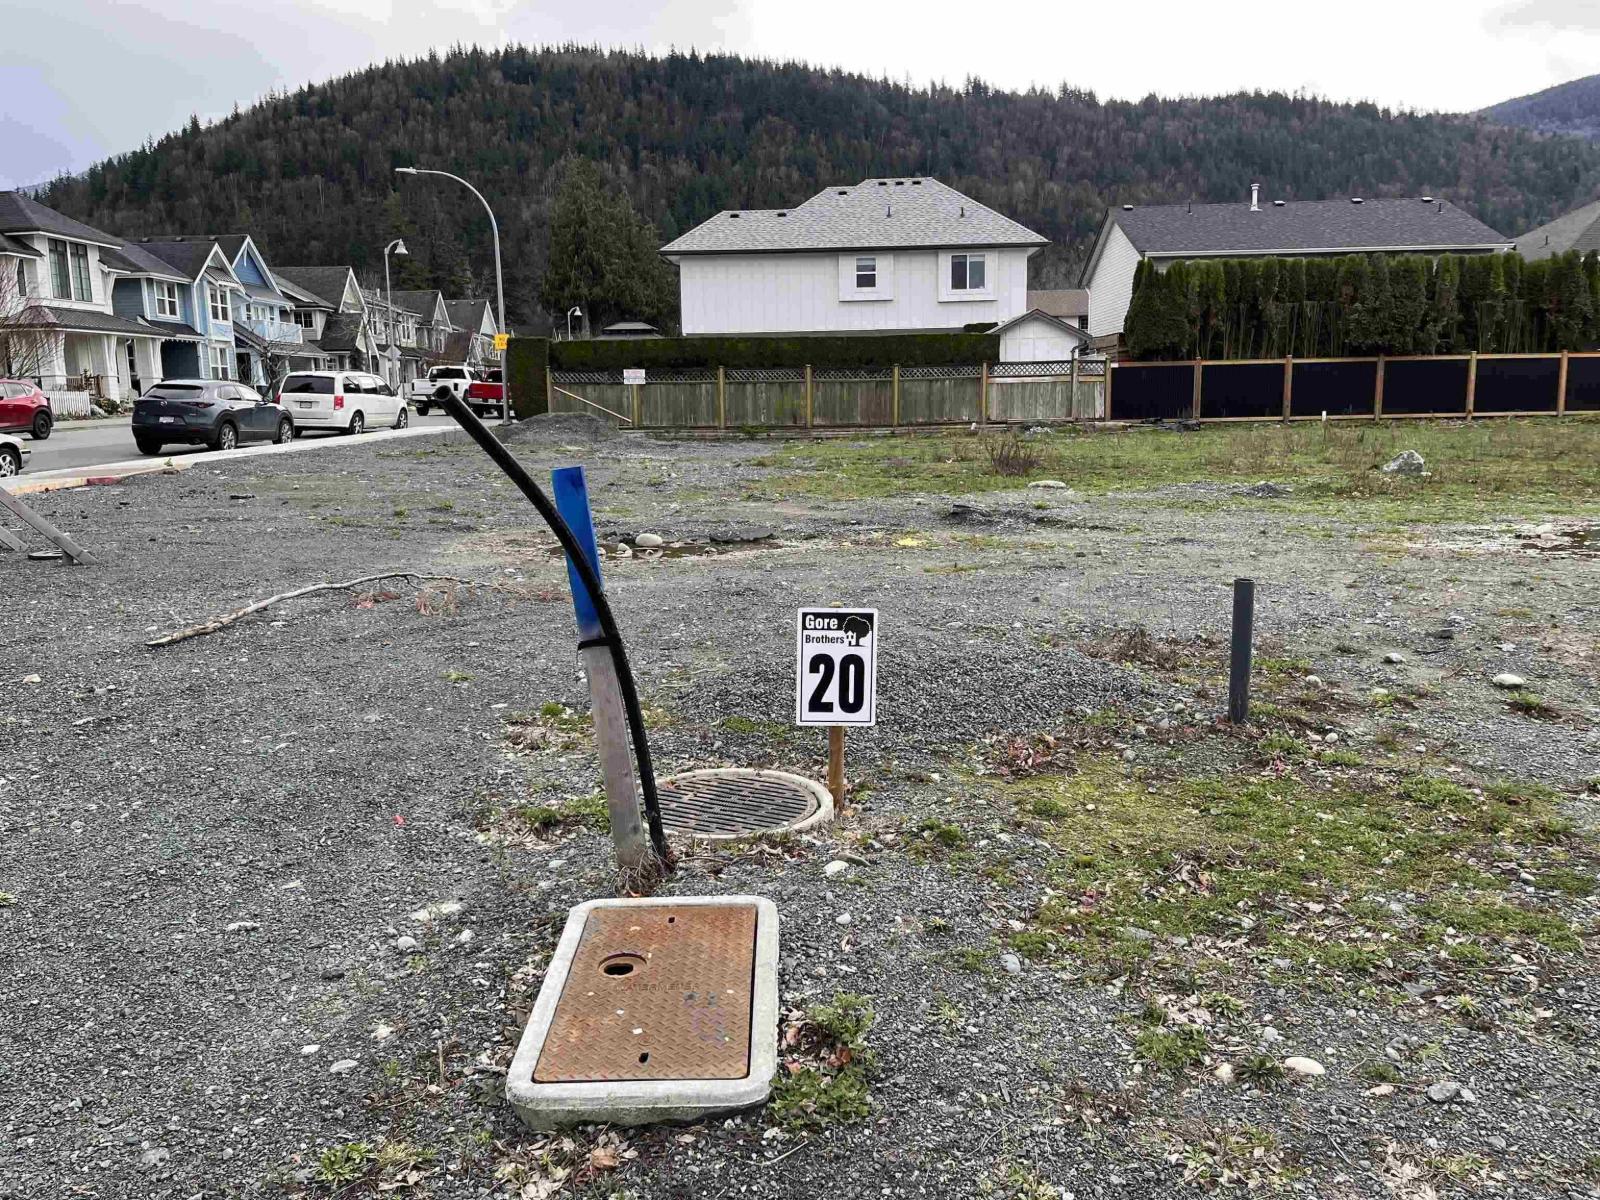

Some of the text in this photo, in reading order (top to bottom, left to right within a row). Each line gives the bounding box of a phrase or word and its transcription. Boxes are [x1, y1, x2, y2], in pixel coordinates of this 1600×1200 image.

[805, 614, 838, 629] Gore
[805, 634, 845, 644] Brothers
[808, 653, 865, 714] 20
